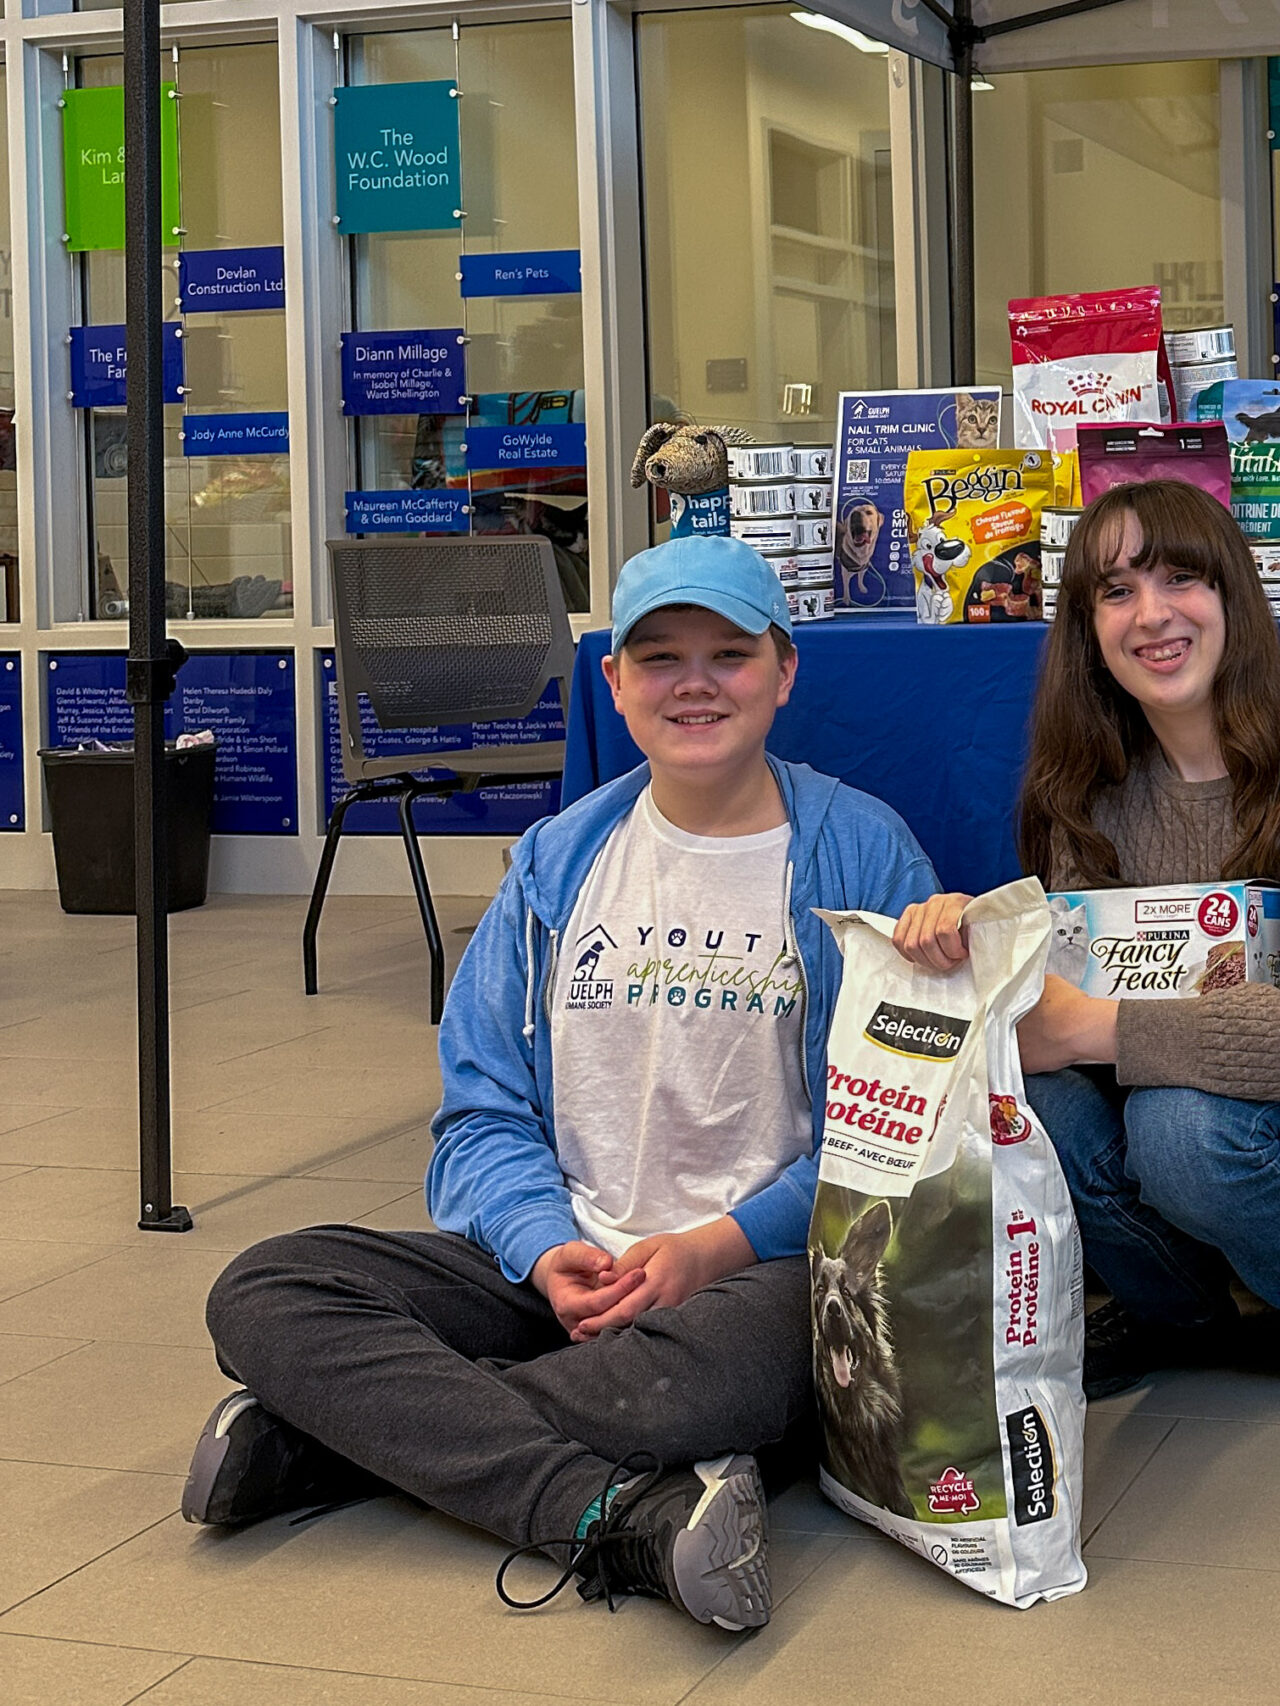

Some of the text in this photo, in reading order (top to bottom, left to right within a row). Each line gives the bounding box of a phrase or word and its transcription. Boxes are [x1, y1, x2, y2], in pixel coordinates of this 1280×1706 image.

[380, 128, 414, 146] The
[348, 147, 448, 169] W.C. Wood
[349, 170, 449, 191] Foundation
[217, 267, 256, 280] Devlan
[495, 267, 549, 280] Ren's Pets
[187, 279, 286, 295] Construction Ltd.
[355, 346, 448, 364] Diann Millage
[353, 368, 452, 382] In memory of Charlie &
[371, 379, 434, 391] Isobel Millage,
[366, 389, 440, 401] Ward Shellington
[1031, 385, 1142, 417] ROYAL CANIN
[191, 427, 290, 443] Jody Anne McCurdy
[848, 423, 936, 435] NAIL TRIM CLINIC
[503, 435, 552, 448] GoWylde
[847, 437, 888, 446] FOR CATS
[498, 448, 558, 460] Real Estate
[847, 447, 853, 455] &
[855, 446, 881, 454] SMALL
[922, 464, 1026, 514] Beggin'
[353, 499, 459, 513] Maureen McCafferty
[361, 512, 453, 524] & Glenn Goddard
[691, 514, 726, 529] tails
[1159, 904, 1191, 914] MORE
[1206, 897, 1231, 918] 24
[1203, 914, 1231, 928] CANS
[1148, 931, 1189, 940] PURINA
[1091, 937, 1188, 970] Fancy
[1106, 964, 1187, 996] Feast
[587, 1001, 613, 1009] SOCIETY
[872, 1014, 962, 1051] Selection
[827, 1137, 916, 1170] BEEF AVEC BŒUF
[1005, 1250, 1022, 1345] Protein
[1023, 1242, 1040, 1347] Protéine
[1022, 1412, 1047, 1518] Selection
[930, 1480, 974, 1494] RECYCLE
